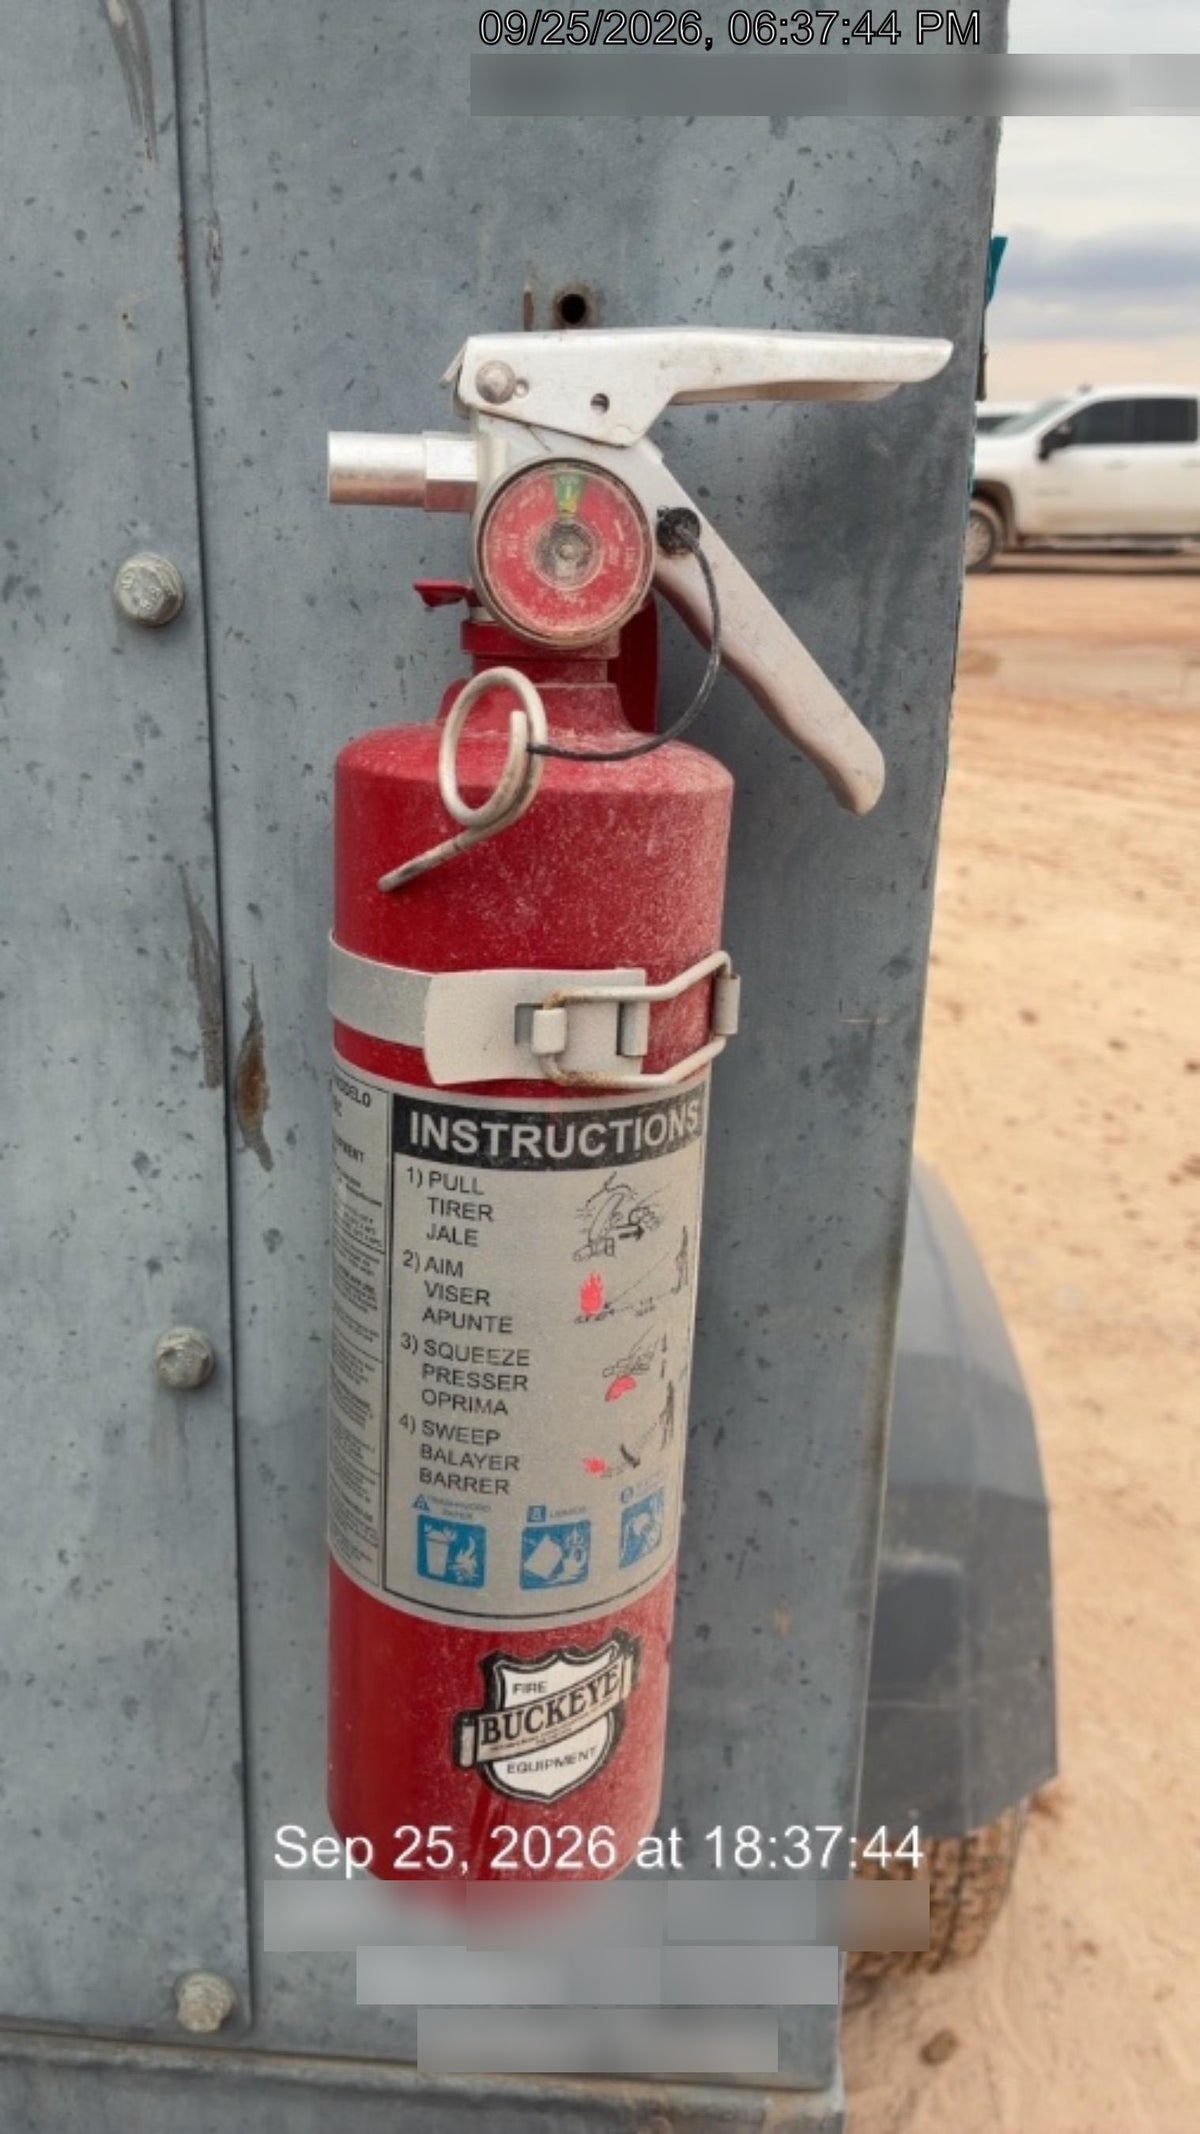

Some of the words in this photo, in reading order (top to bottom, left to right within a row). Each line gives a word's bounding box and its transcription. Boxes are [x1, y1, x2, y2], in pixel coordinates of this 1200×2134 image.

[409, 1103, 700, 1159] INSTRUCTIONS
[405, 1166, 423, 1189] 1)
[428, 1171, 485, 1195] PULL
[426, 1196, 494, 1223] TIRER
[426, 1223, 479, 1248] JALE
[402, 1250, 421, 1274] 2)
[423, 1256, 464, 1278] AIM
[424, 1280, 491, 1307] VISER
[422, 1306, 513, 1334] APUNTE
[400, 1337, 419, 1356] 3)
[423, 1338, 530, 1367] SQUEEZE
[422, 1363, 529, 1392] PRESSER
[421, 1389, 509, 1416] OPRIMA
[398, 1415, 416, 1435] 4)
[421, 1419, 501, 1446] SWEEP
[420, 1443, 520, 1472] BALAYER
[418, 1468, 510, 1496] BARRER
[513, 1681, 548, 1694] FIRE
[480, 1666, 620, 1746] BUCKEYE
[506, 1747, 598, 1774] EQUIPMENT
